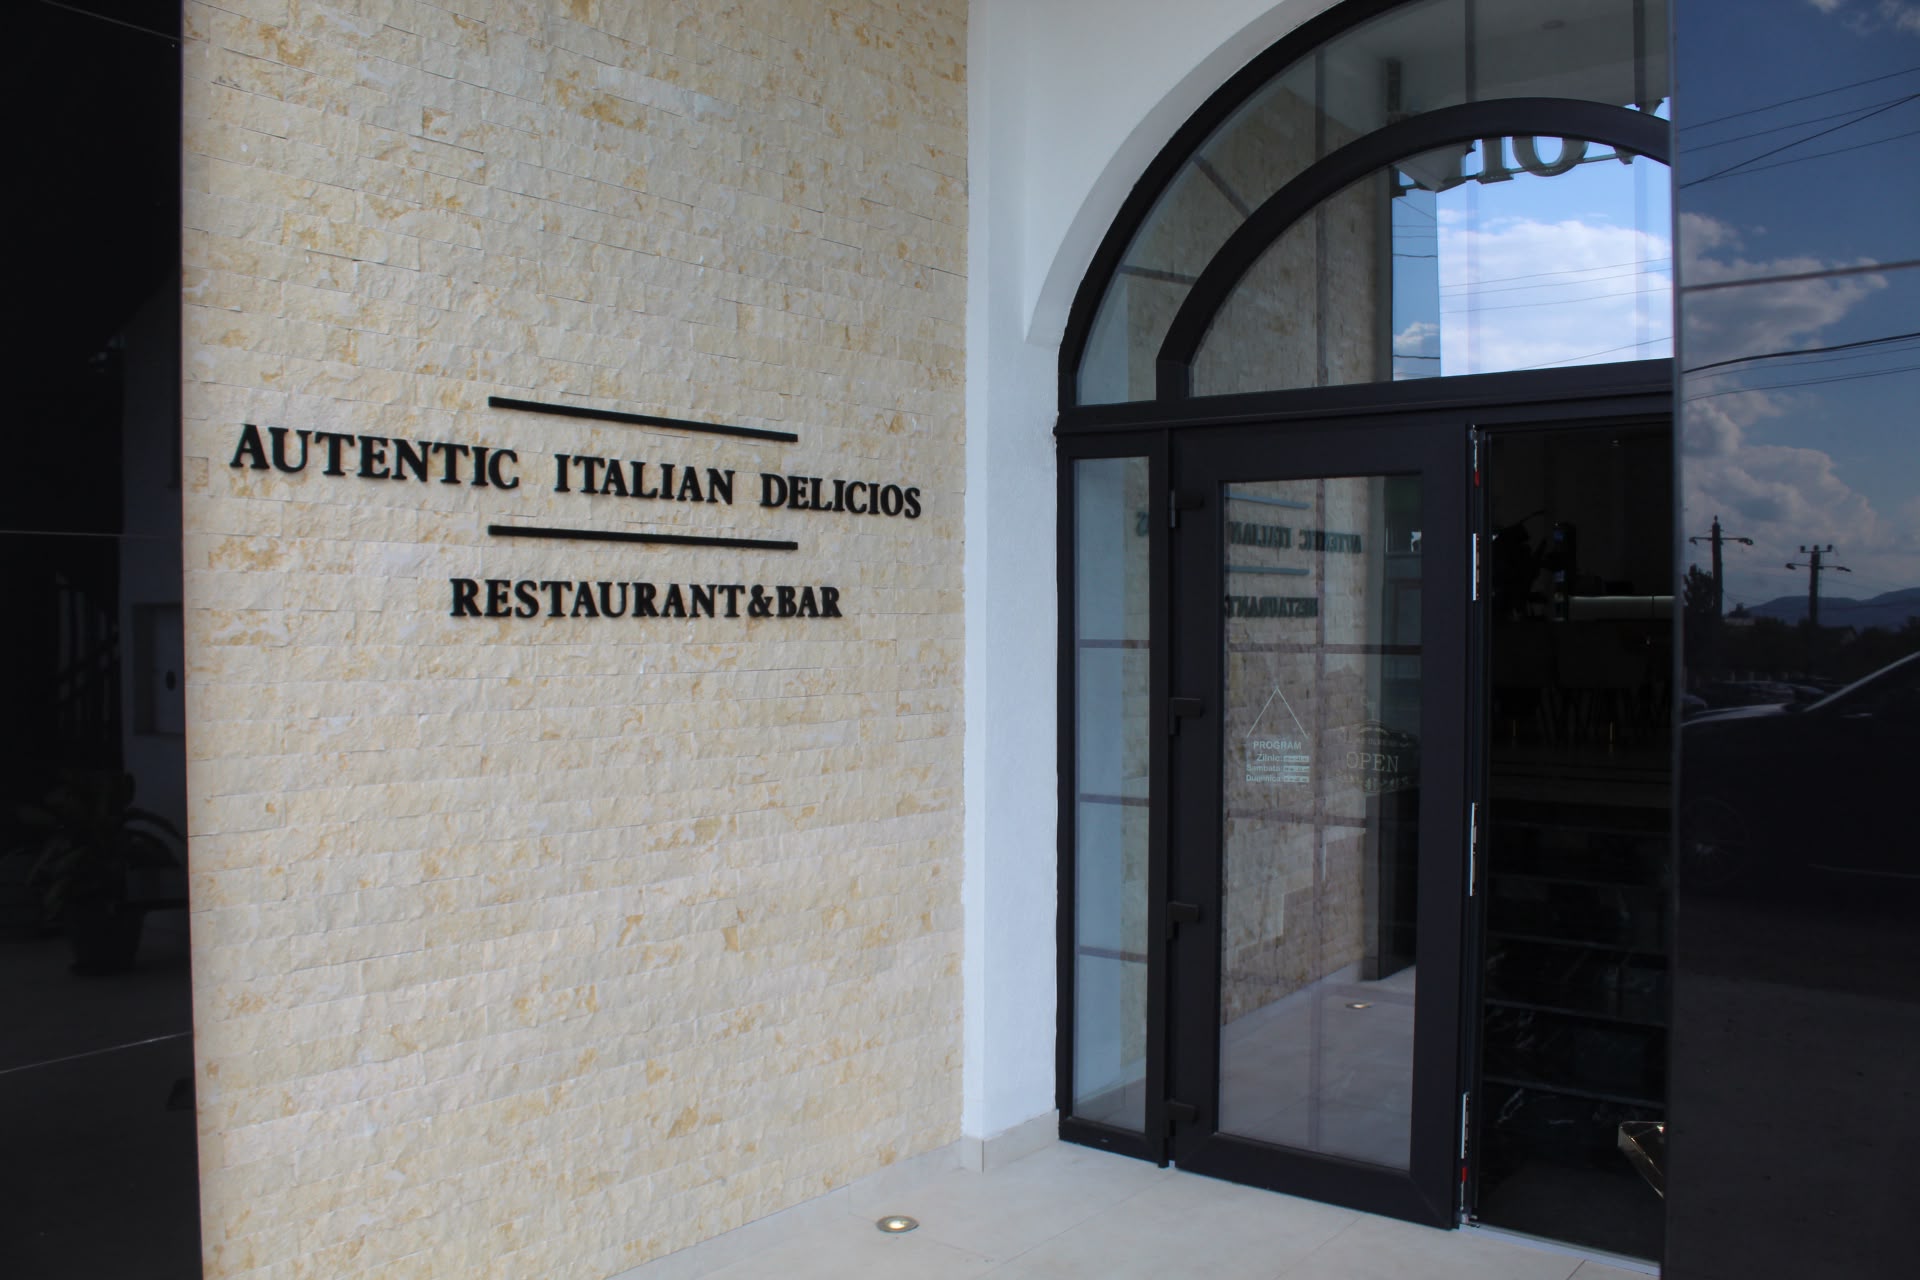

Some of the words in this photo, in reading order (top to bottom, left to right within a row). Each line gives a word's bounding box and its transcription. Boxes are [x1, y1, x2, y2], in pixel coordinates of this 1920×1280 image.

[230, 424, 520, 490] AUTENTIC
[554, 453, 736, 505] ITALIAN
[759, 472, 922, 519] DELICIOS
[450, 578, 843, 620] RESTAURANT&BAR
[1253, 740, 1302, 750] PROGRAM
[1346, 751, 1400, 773] OPEN
